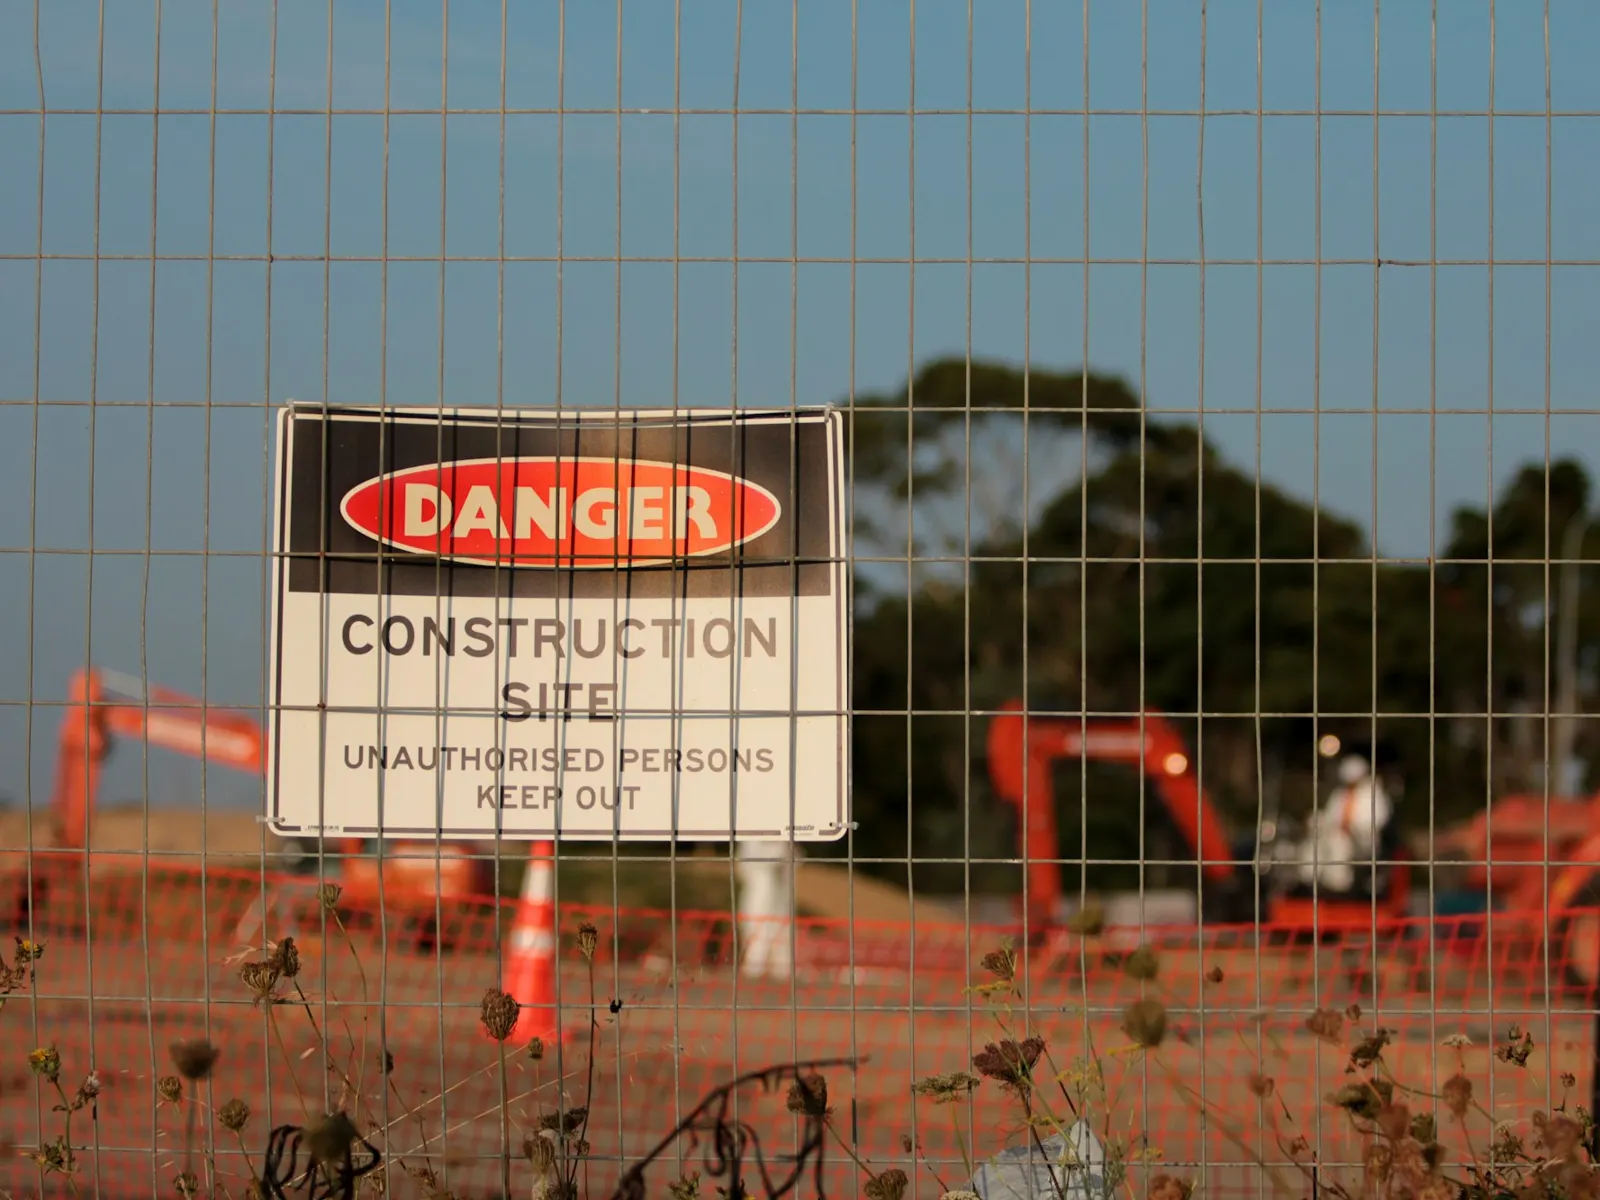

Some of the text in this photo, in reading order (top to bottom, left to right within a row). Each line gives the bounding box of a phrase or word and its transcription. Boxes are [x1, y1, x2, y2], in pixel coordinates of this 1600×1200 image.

[404, 483, 718, 540] DANGER
[342, 614, 777, 659] CONSTRUCTION
[501, 682, 619, 723] SITE
[344, 745, 774, 773] UNAUTHORISED PERSONS
[477, 785, 641, 810] KEEP OUT
